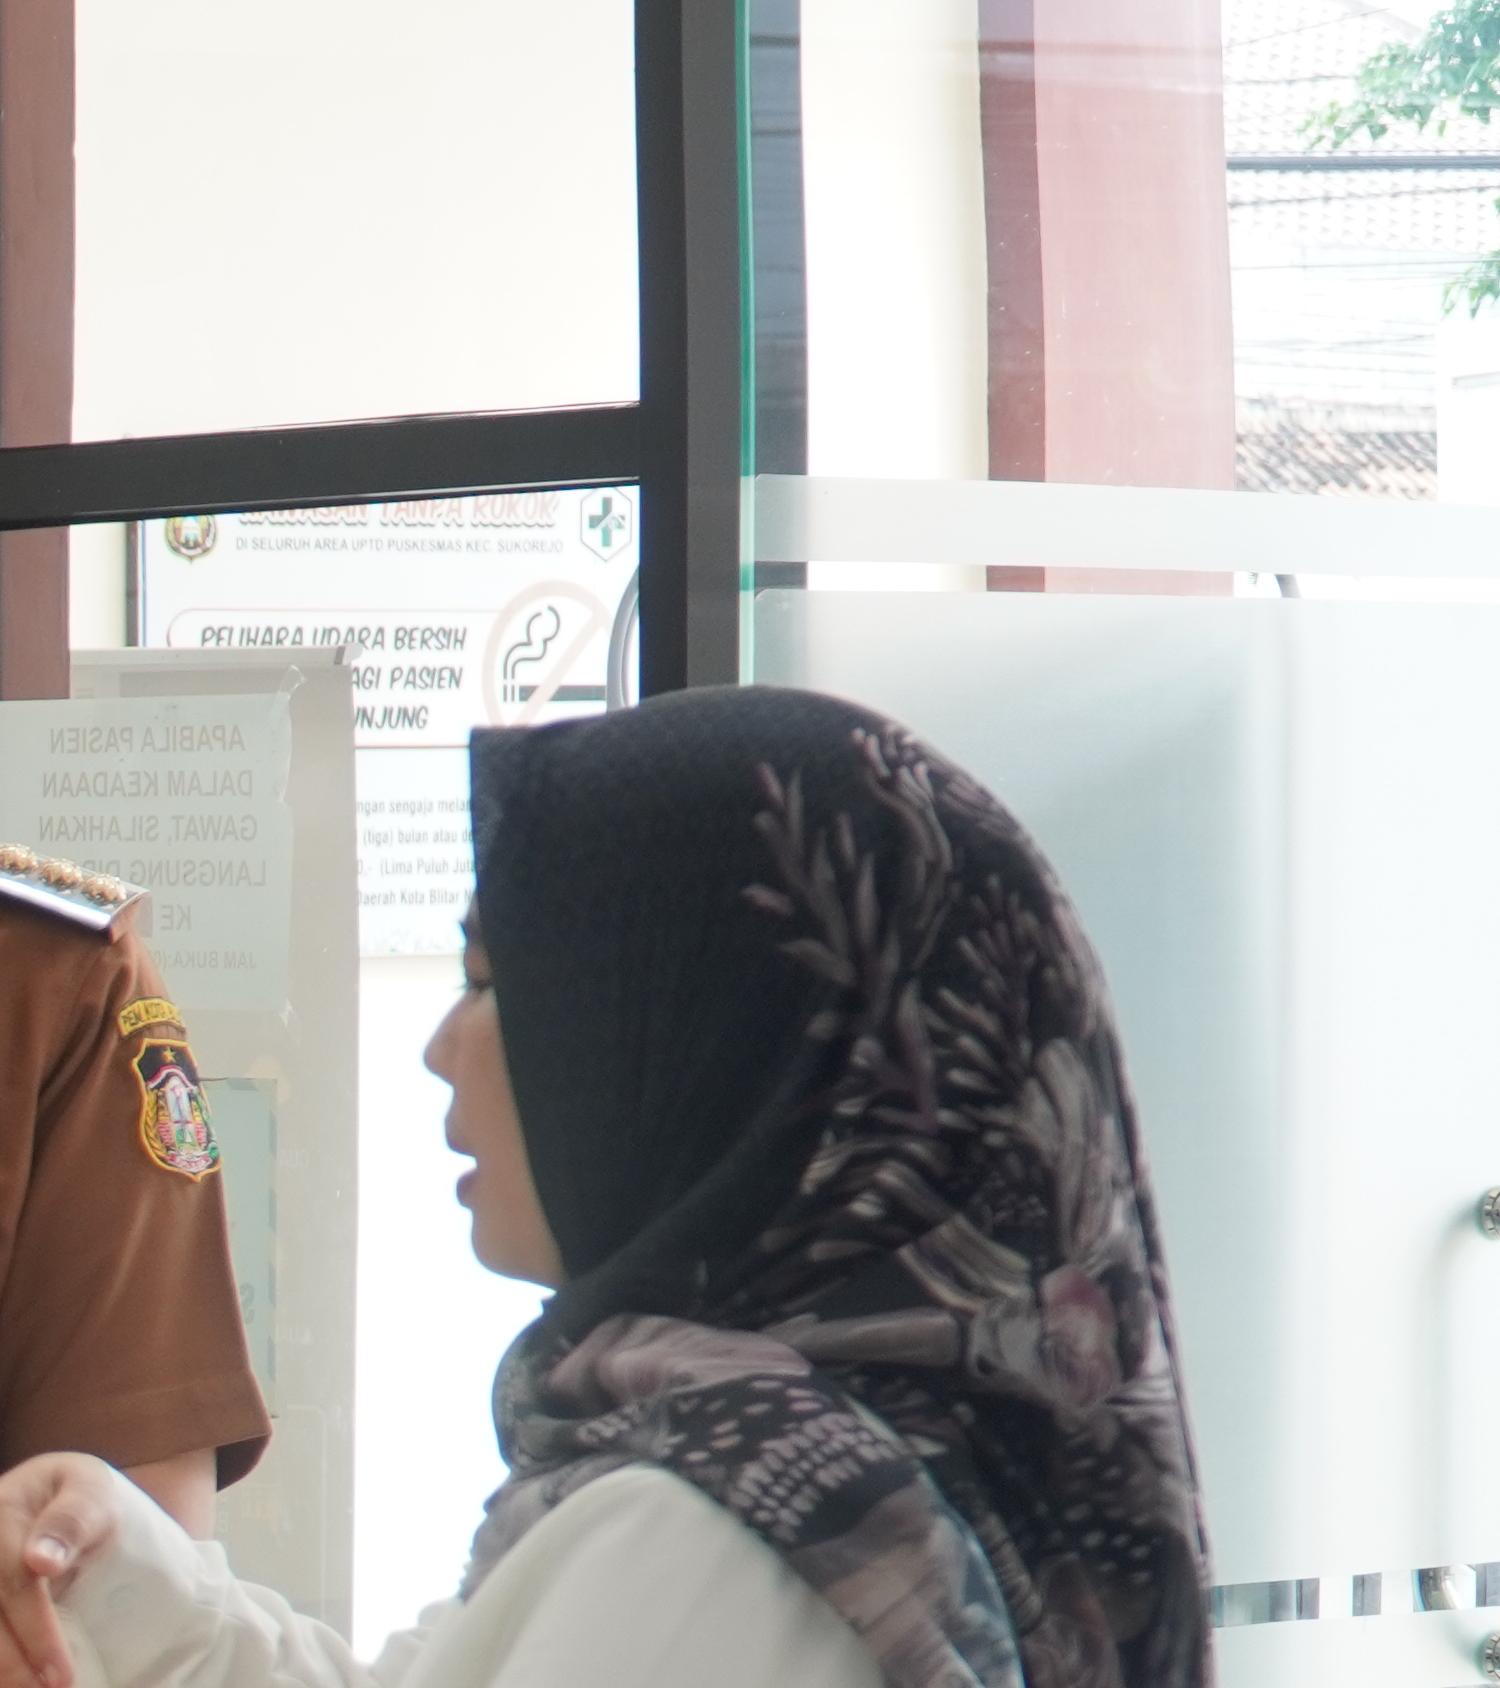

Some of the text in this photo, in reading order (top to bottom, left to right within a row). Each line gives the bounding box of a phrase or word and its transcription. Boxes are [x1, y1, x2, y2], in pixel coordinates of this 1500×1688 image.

[236, 538, 247, 551] DI
[251, 538, 311, 551] SELURUH
[314, 538, 349, 551] AREA
[351, 538, 384, 552] UPTD
[387, 538, 463, 552] PUSKESMAS
[497, 540, 564, 554] SUKOREJO
[394, 626, 467, 651] BERSIH
[351, 666, 463, 690] AGI PASIEN
[354, 706, 429, 731] NJUNG
[389, 797, 434, 816] sengaja
[398, 828, 429, 843] bulan
[433, 829, 457, 843] atau
[417, 859, 449, 875] Puluh
[400, 889, 425, 905] Kota
[429, 889, 459, 905] Blitar
